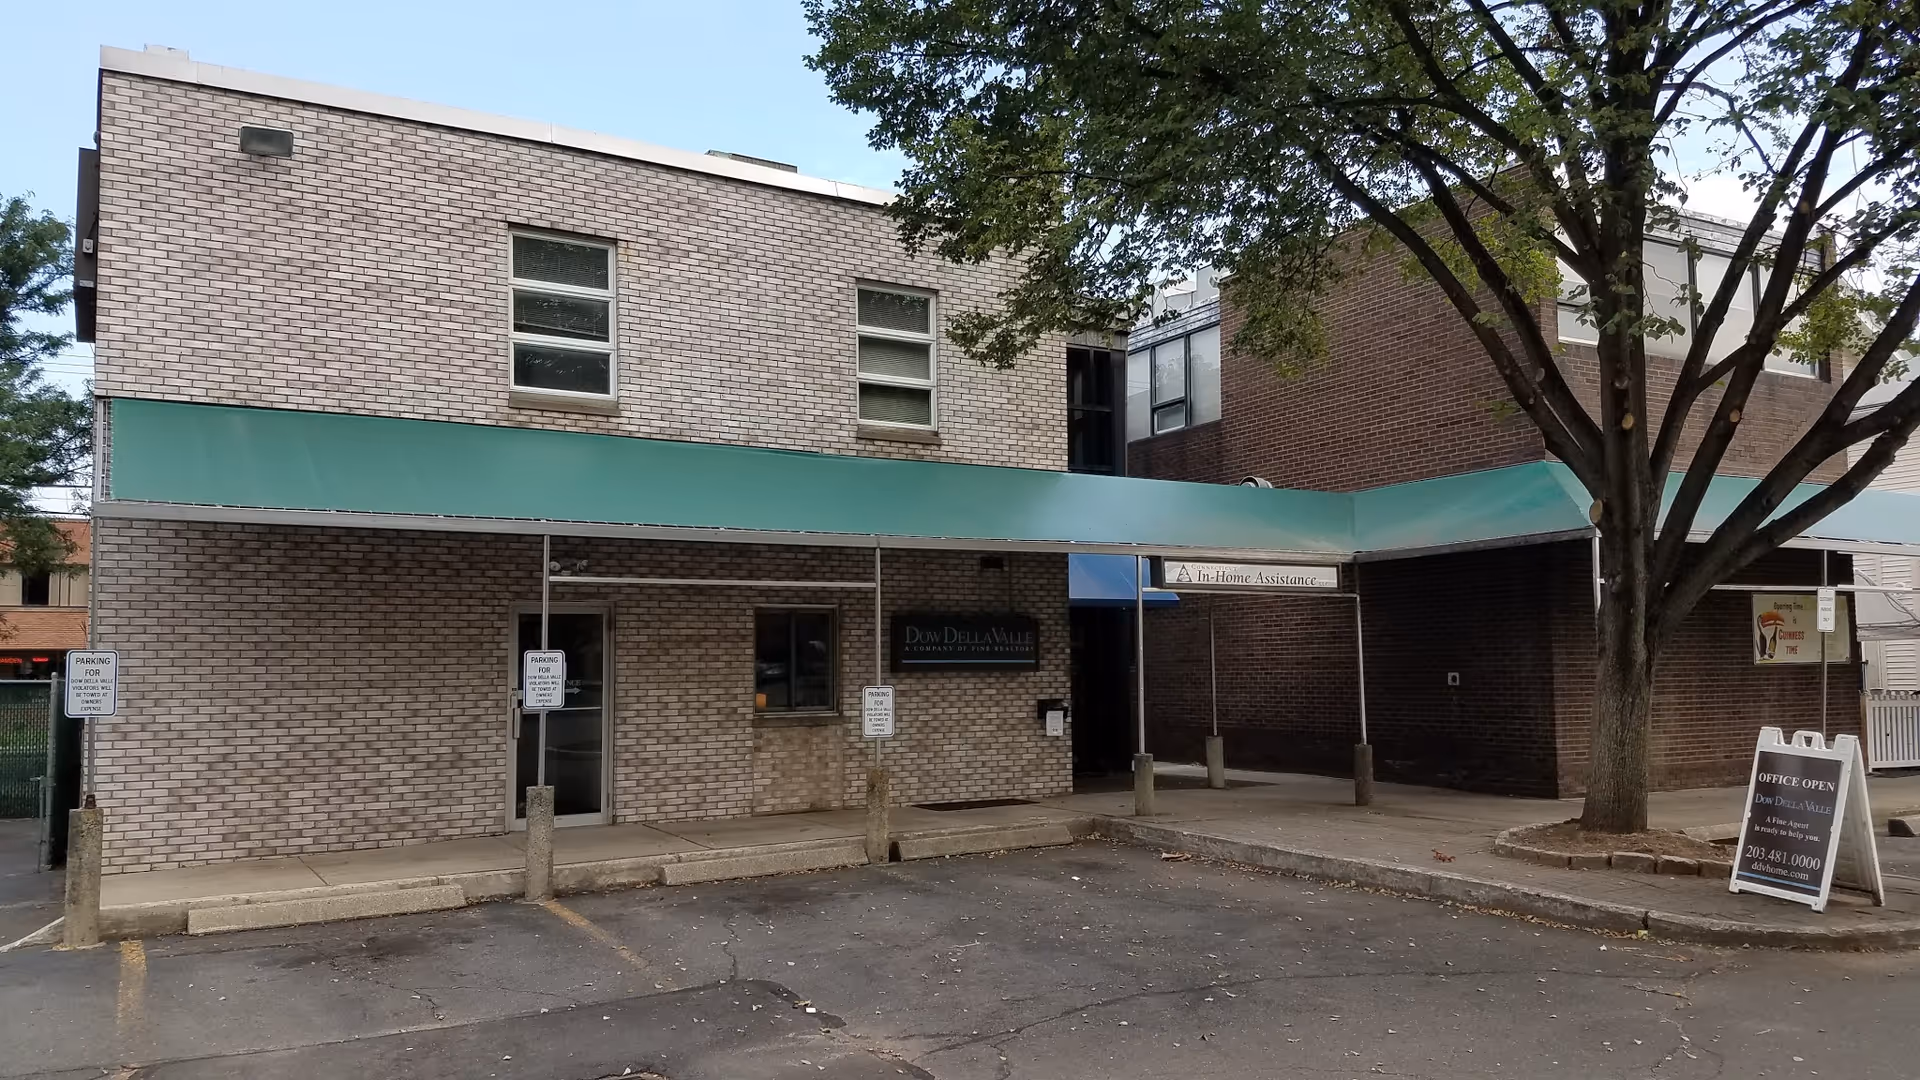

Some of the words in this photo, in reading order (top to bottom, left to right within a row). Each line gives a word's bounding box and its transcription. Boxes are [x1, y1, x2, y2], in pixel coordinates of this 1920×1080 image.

[1197, 570, 1251, 583] In-Home
[1254, 571, 1317, 586] Assistance
[1778, 629, 1804, 640] GUINNESS
[1785, 646, 1798, 655] TIME
[75, 657, 111, 665] PARKING
[530, 656, 559, 664] PARKING
[84, 668, 100, 677] FOR
[538, 666, 551, 674] FOR
[1758, 772, 1800, 787] OFFICE
[1802, 778, 1835, 792] OPEN
[1755, 793, 1774, 805] DOW
[1772, 816, 1787, 826] Fine
[1787, 819, 1809, 830] Agent
[1754, 824, 1760, 832] is
[1760, 825, 1779, 836] ready
[1788, 831, 1804, 841] help
[1804, 834, 1821, 842] you.
[1745, 845, 1821, 871] 203.481.0000
[1751, 861, 1809, 881] ddvhome.com
